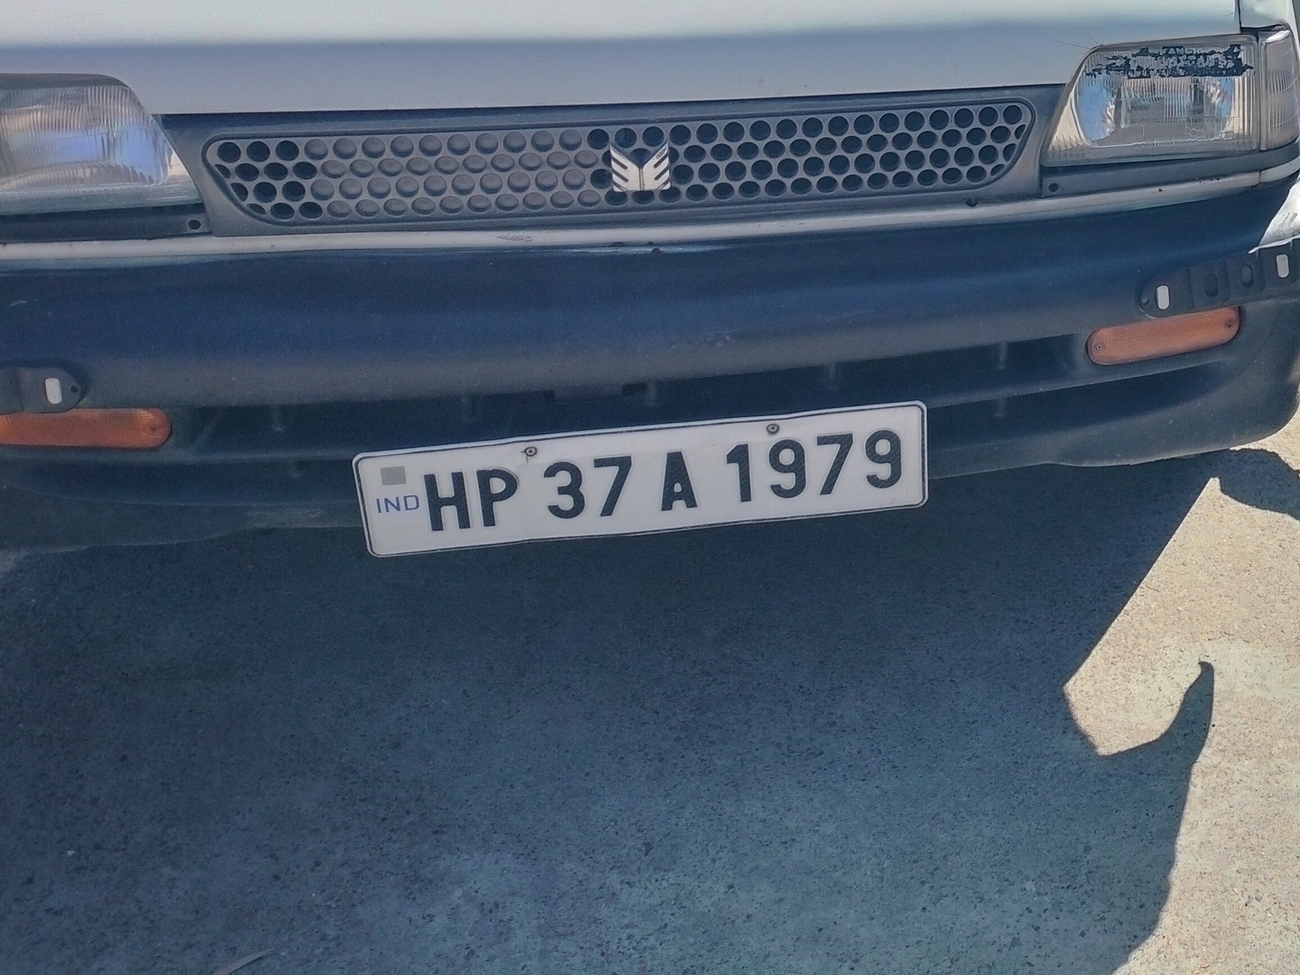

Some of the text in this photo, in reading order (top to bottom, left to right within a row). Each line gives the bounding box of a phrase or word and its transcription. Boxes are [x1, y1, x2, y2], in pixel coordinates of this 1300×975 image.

[376, 494, 420, 514] IND
[423, 429, 903, 532] HP 37 A 1979
